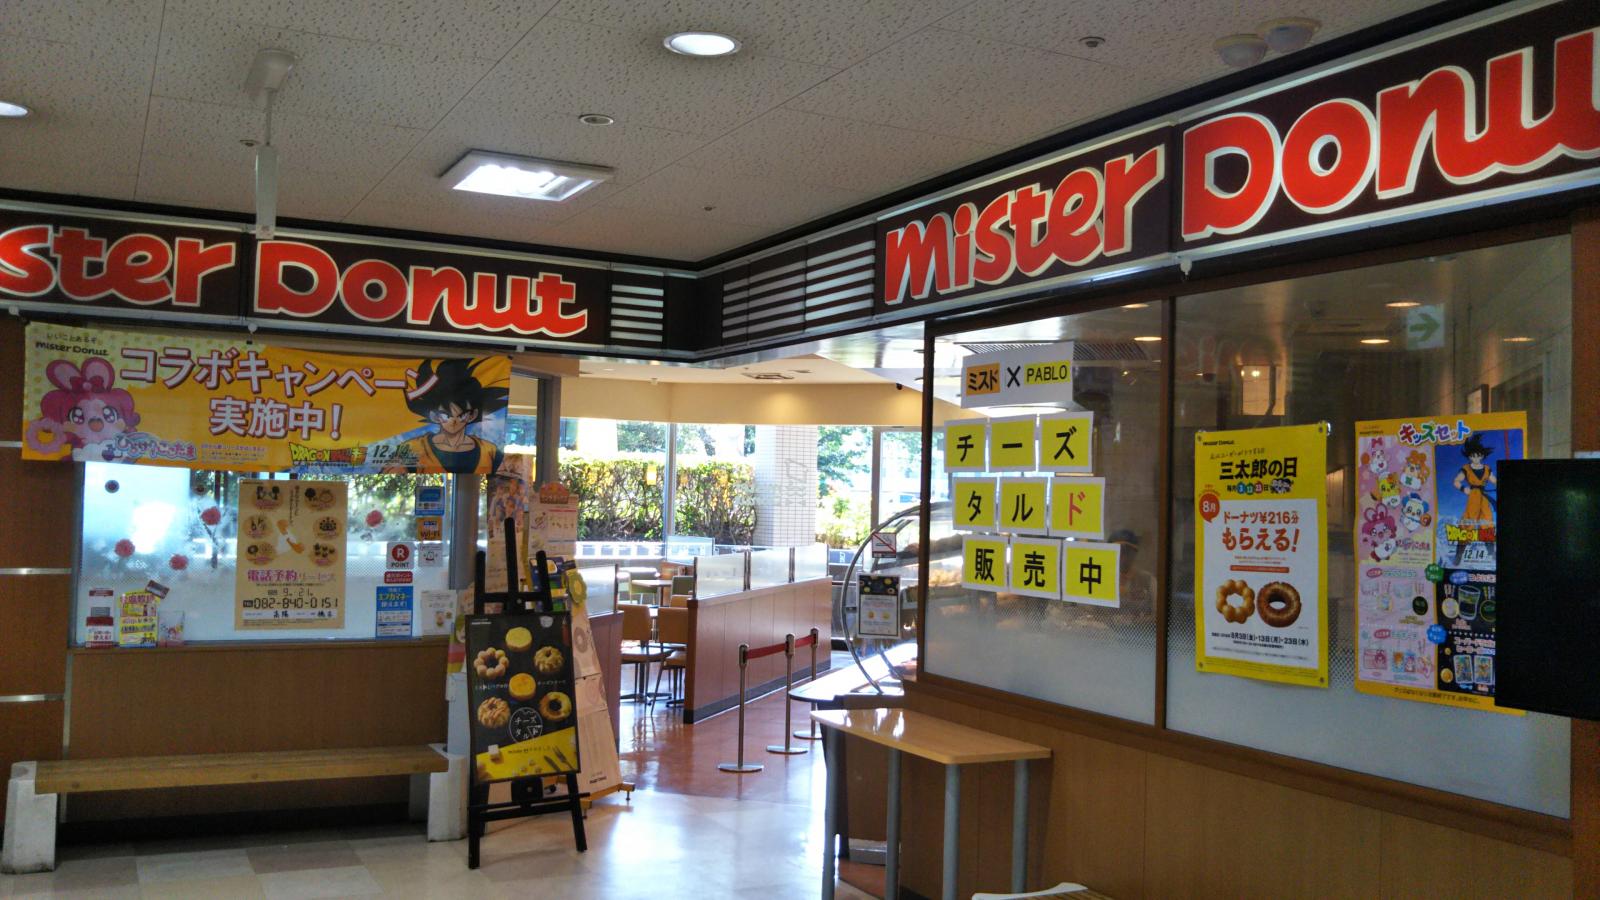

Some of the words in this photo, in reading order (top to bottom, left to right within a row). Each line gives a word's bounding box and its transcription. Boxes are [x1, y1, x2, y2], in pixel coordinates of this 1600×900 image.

[254, 238, 588, 338] Donut
[120, 347, 438, 400] コラボキャンペーン
[967, 369, 999, 391] ミスド
[1026, 364, 1069, 382] PABLO
[1399, 419, 1470, 445] キッズセット
[1219, 456, 1298, 480] 三太郎の日
[1202, 501, 1216, 513] 8月
[253, 598, 338, 609] 082-840-0151
